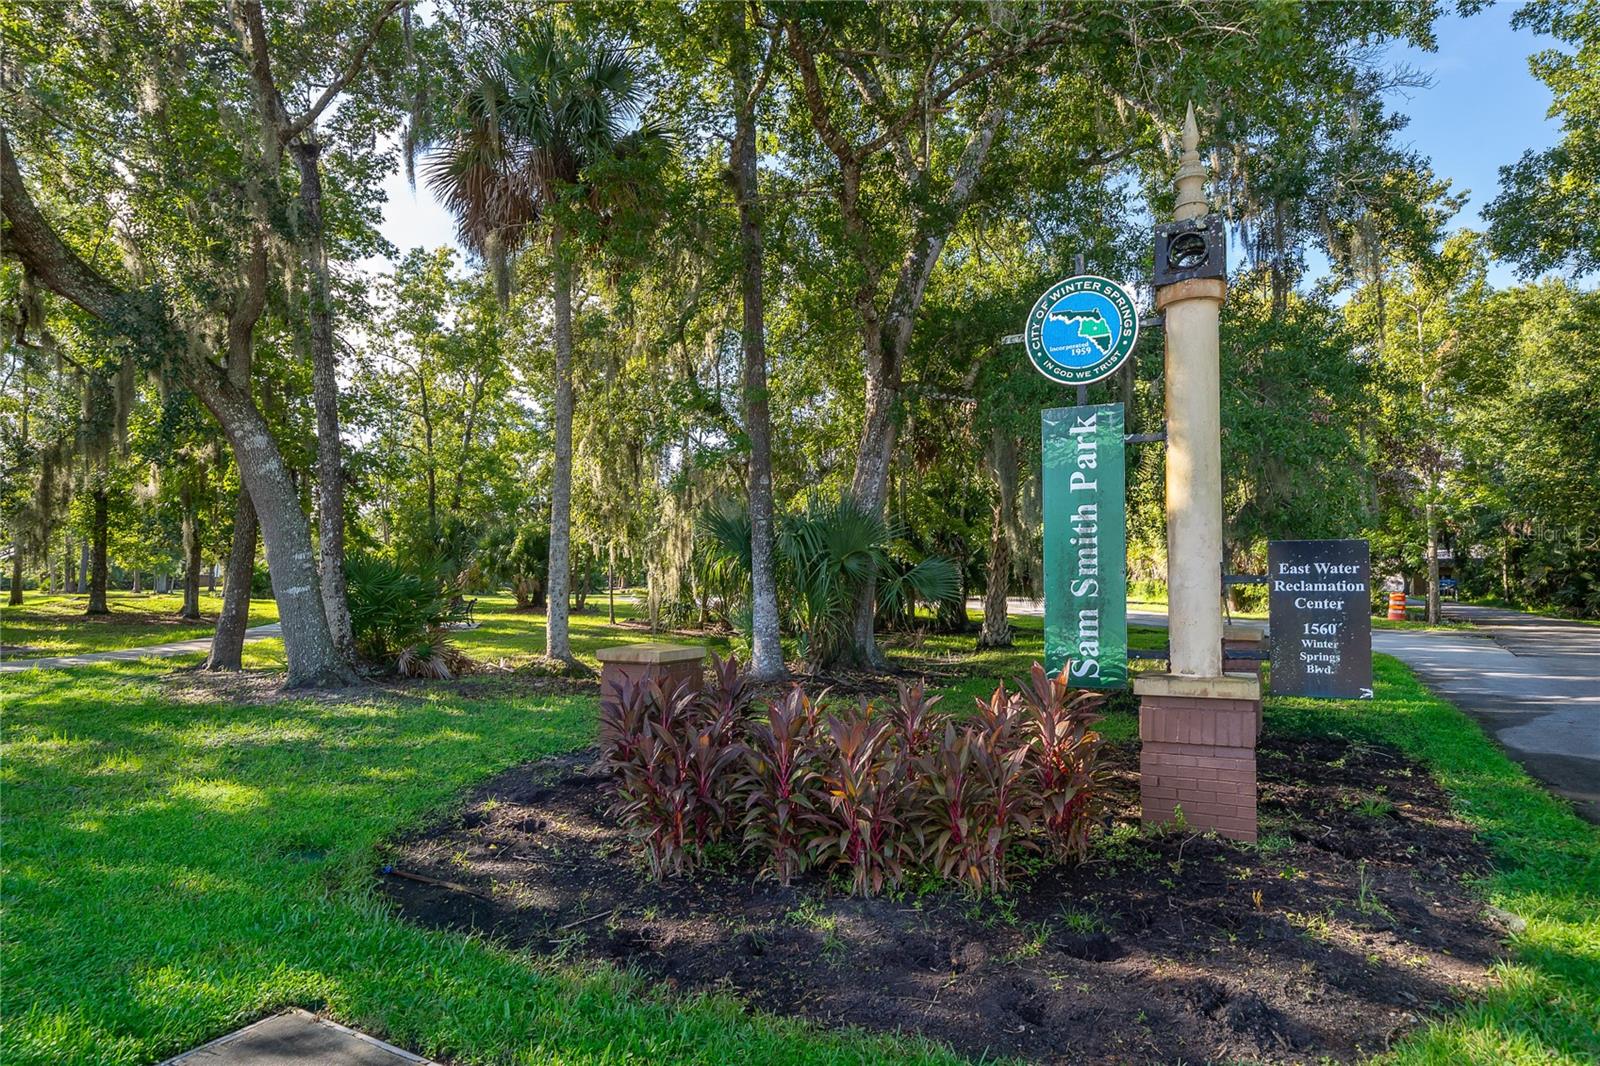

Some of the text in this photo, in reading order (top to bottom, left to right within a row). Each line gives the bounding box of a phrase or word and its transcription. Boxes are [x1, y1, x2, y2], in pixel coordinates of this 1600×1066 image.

[1031, 281, 1133, 350] CITY OF WINTER SPRINGS
[1049, 342, 1090, 352] Incorporated
[1071, 347, 1092, 356] 1959
[1043, 360, 1053, 370] IN
[1053, 367, 1074, 378] GOD
[1093, 351, 1122, 375] TRUST
[1069, 412, 1099, 678] Sam Smith Park
[1279, 563, 1360, 574] East Water
[1274, 580, 1365, 592] Reclamation
[1294, 597, 1344, 610] Center
[1303, 623, 1337, 635] 1560
[1301, 639, 1338, 648] Winter
[1300, 652, 1341, 664] Springs
[1306, 665, 1334, 674] Blvd.
